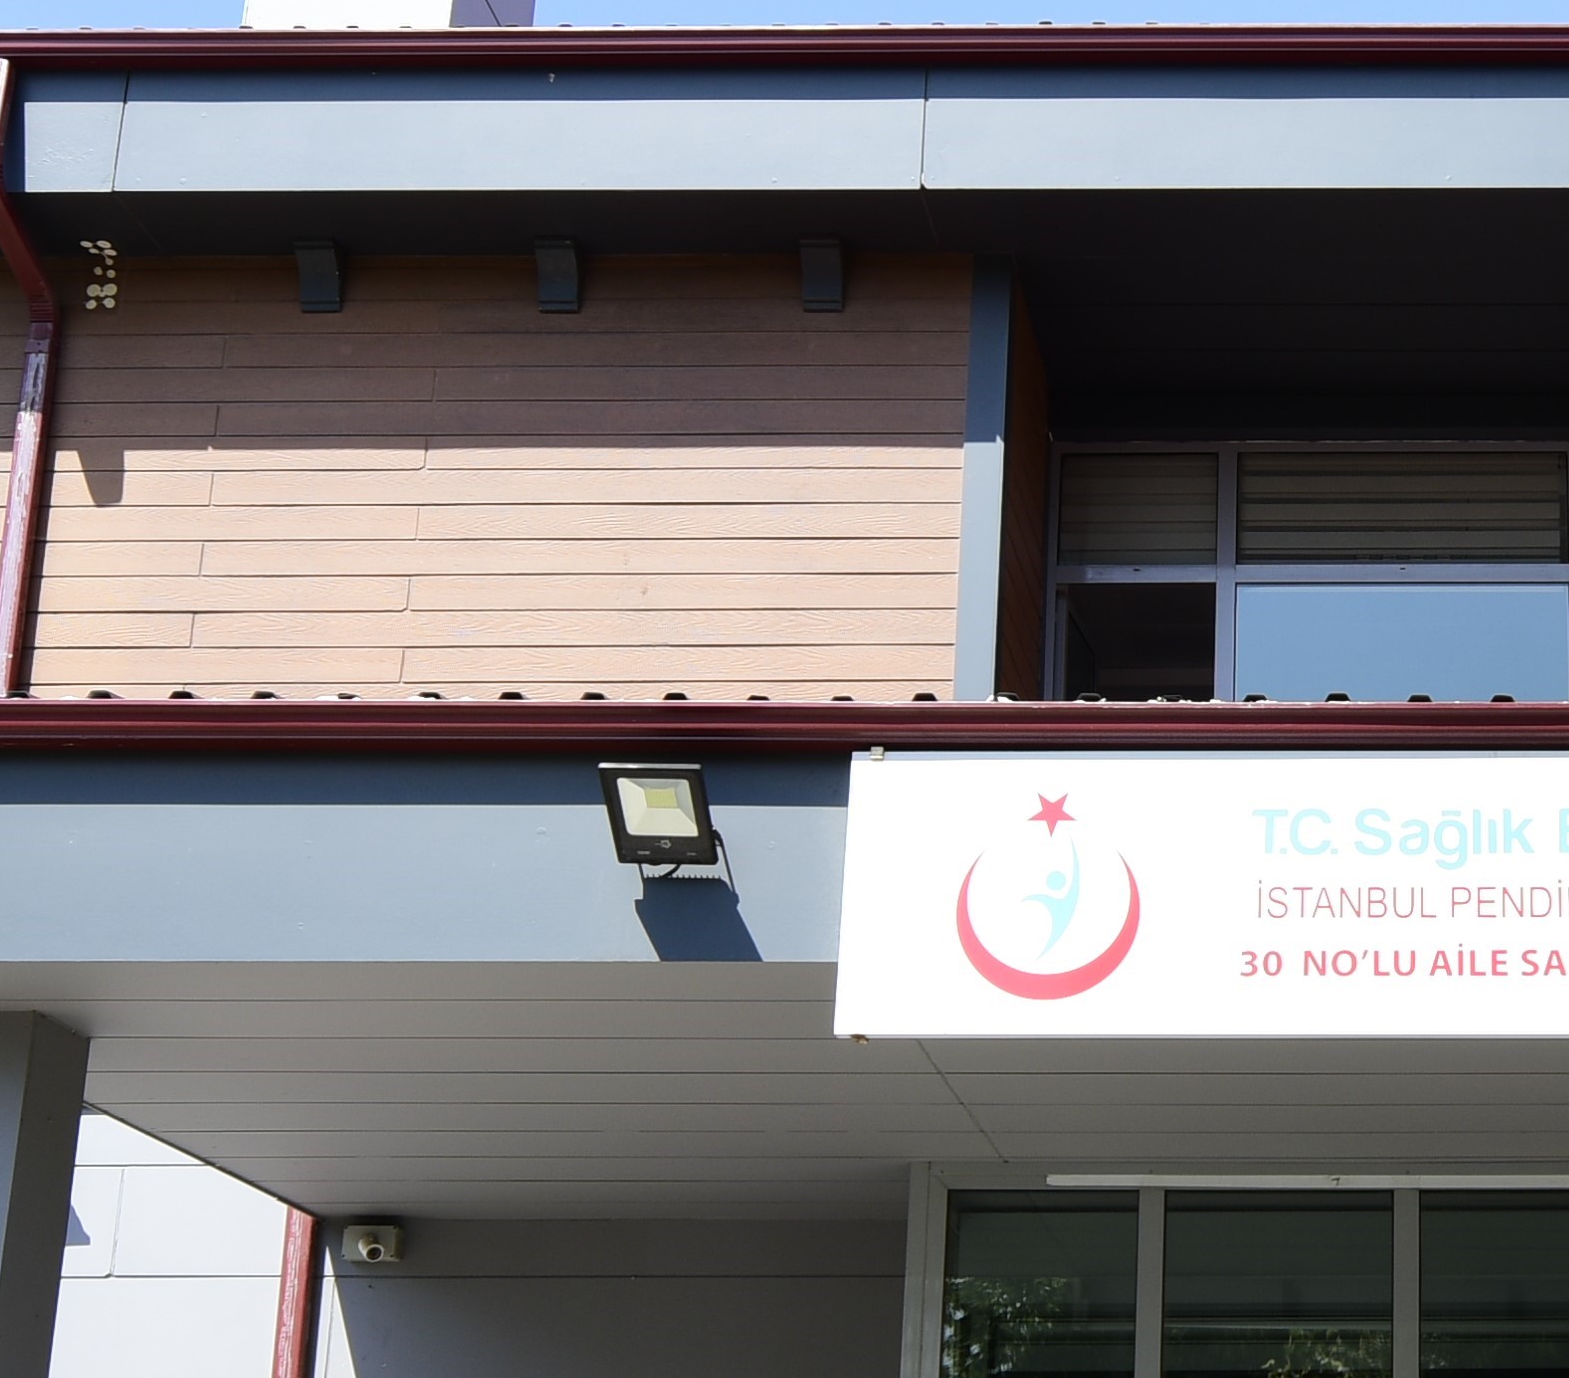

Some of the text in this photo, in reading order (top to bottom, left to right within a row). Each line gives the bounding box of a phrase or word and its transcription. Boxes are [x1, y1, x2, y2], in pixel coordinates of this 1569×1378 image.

[1252, 808, 1338, 855] T.C.
[1354, 808, 1535, 871] Sağlık
[1257, 879, 1437, 919] İSTANBUL
[1241, 950, 1284, 978] 30
[1430, 942, 1509, 977] AİLE
